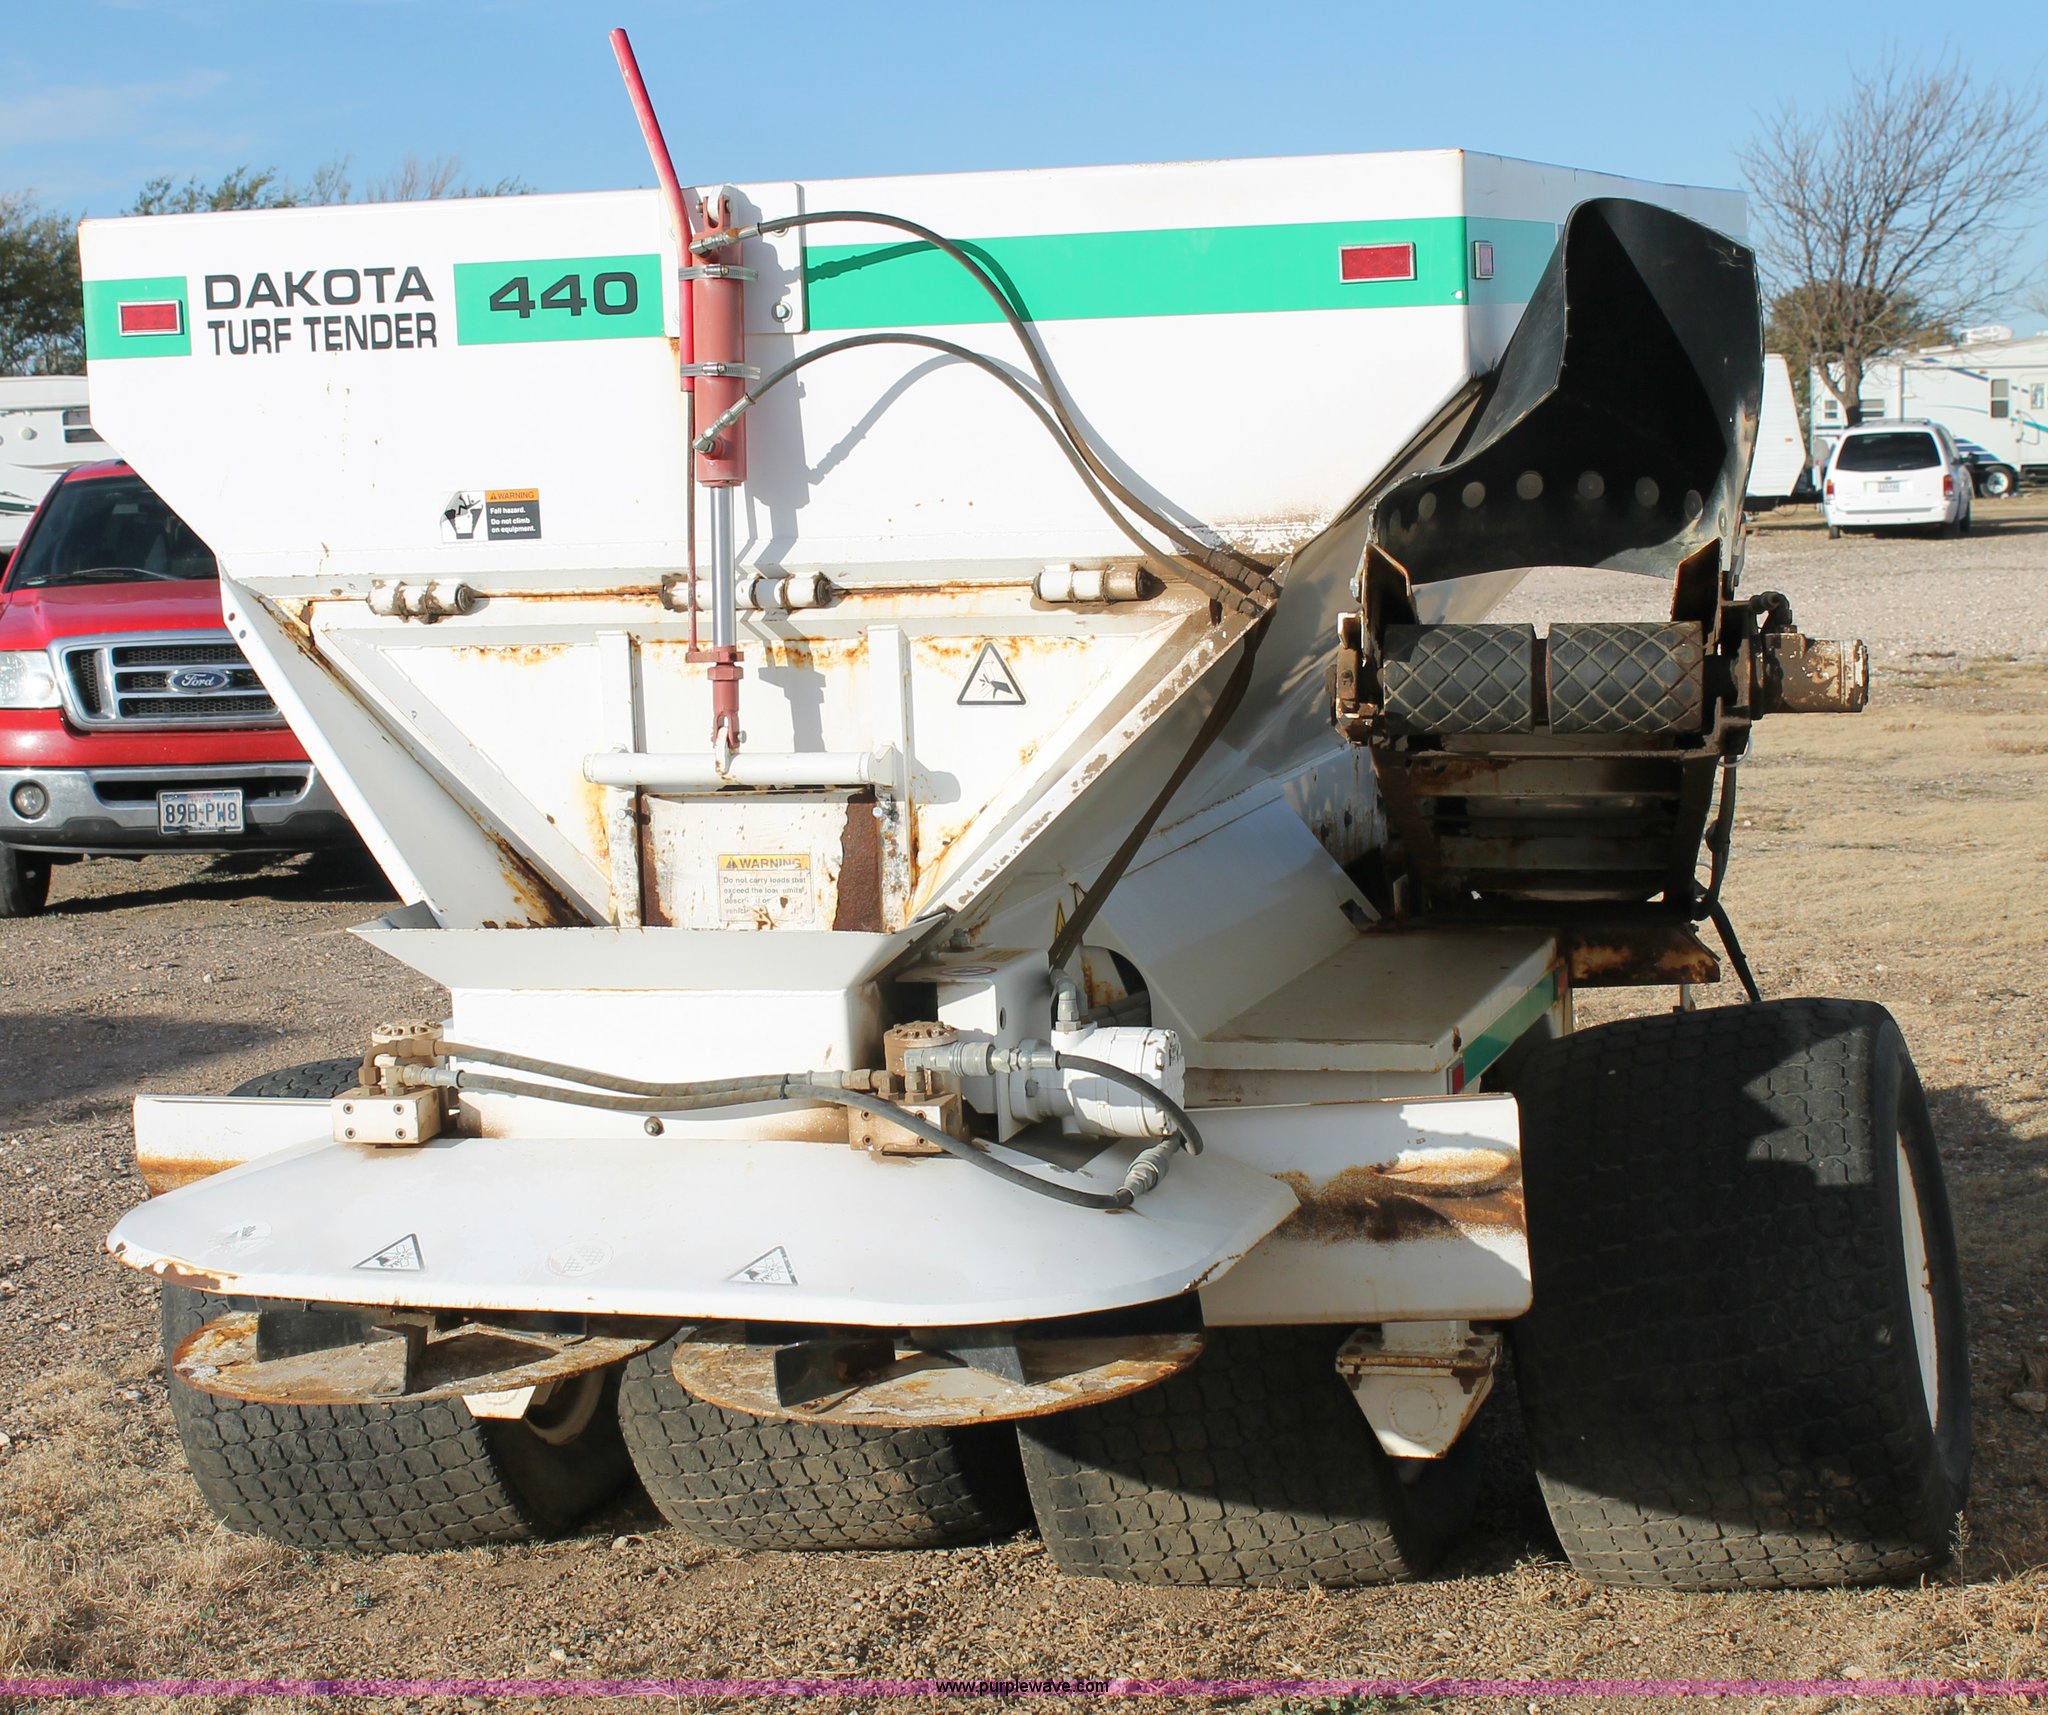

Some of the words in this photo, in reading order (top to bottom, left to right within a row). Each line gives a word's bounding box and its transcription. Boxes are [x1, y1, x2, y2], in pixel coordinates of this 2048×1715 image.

[205, 266, 434, 310] DAKOTA
[489, 271, 639, 319] 440
[207, 317, 292, 356] TURF
[303, 312, 437, 352] TENDER
[498, 491, 535, 500] WARNING
[503, 506, 526, 514] hazard.
[501, 525, 536, 534] equipment.
[181, 673, 215, 687] Ford
[739, 858, 802, 869] WARNING
